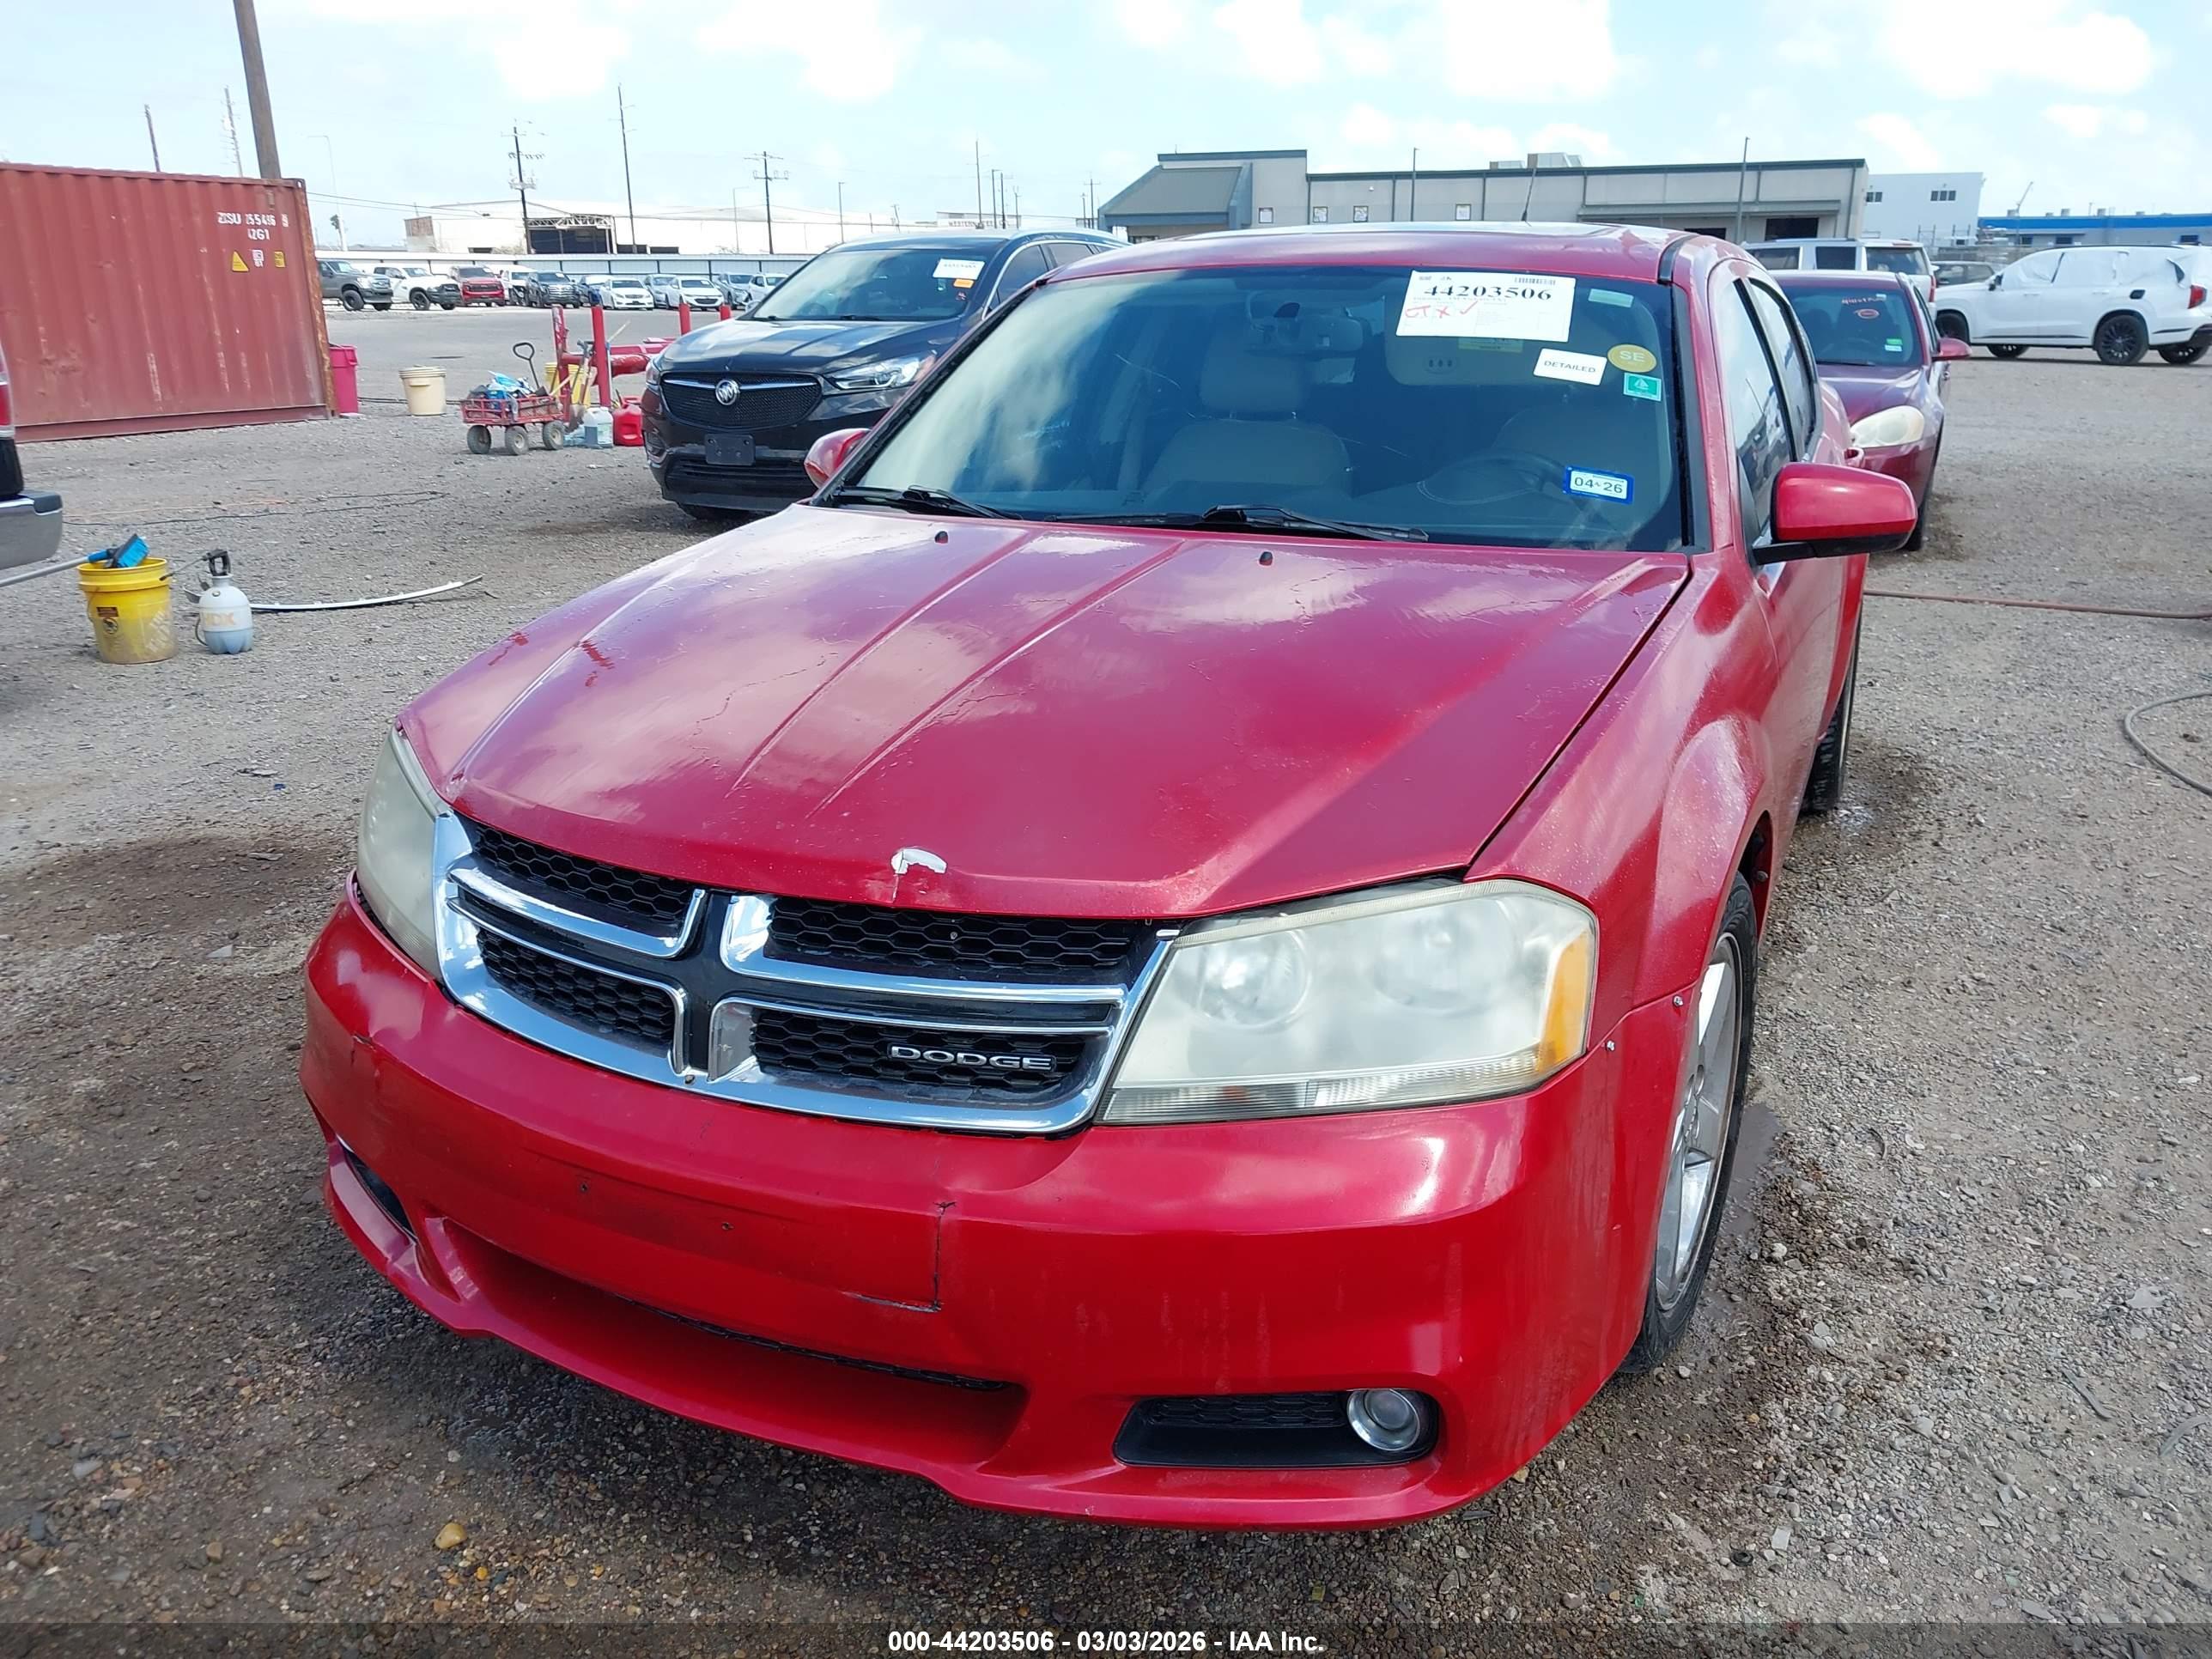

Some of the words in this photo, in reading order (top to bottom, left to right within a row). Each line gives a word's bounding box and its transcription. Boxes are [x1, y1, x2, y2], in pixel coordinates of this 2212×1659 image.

[1424, 284, 1552, 301] 44203506
[1619, 349, 1645, 362] SE
[1543, 359, 1597, 374] DETAILED
[890, 1046, 1053, 1071] DODGE
